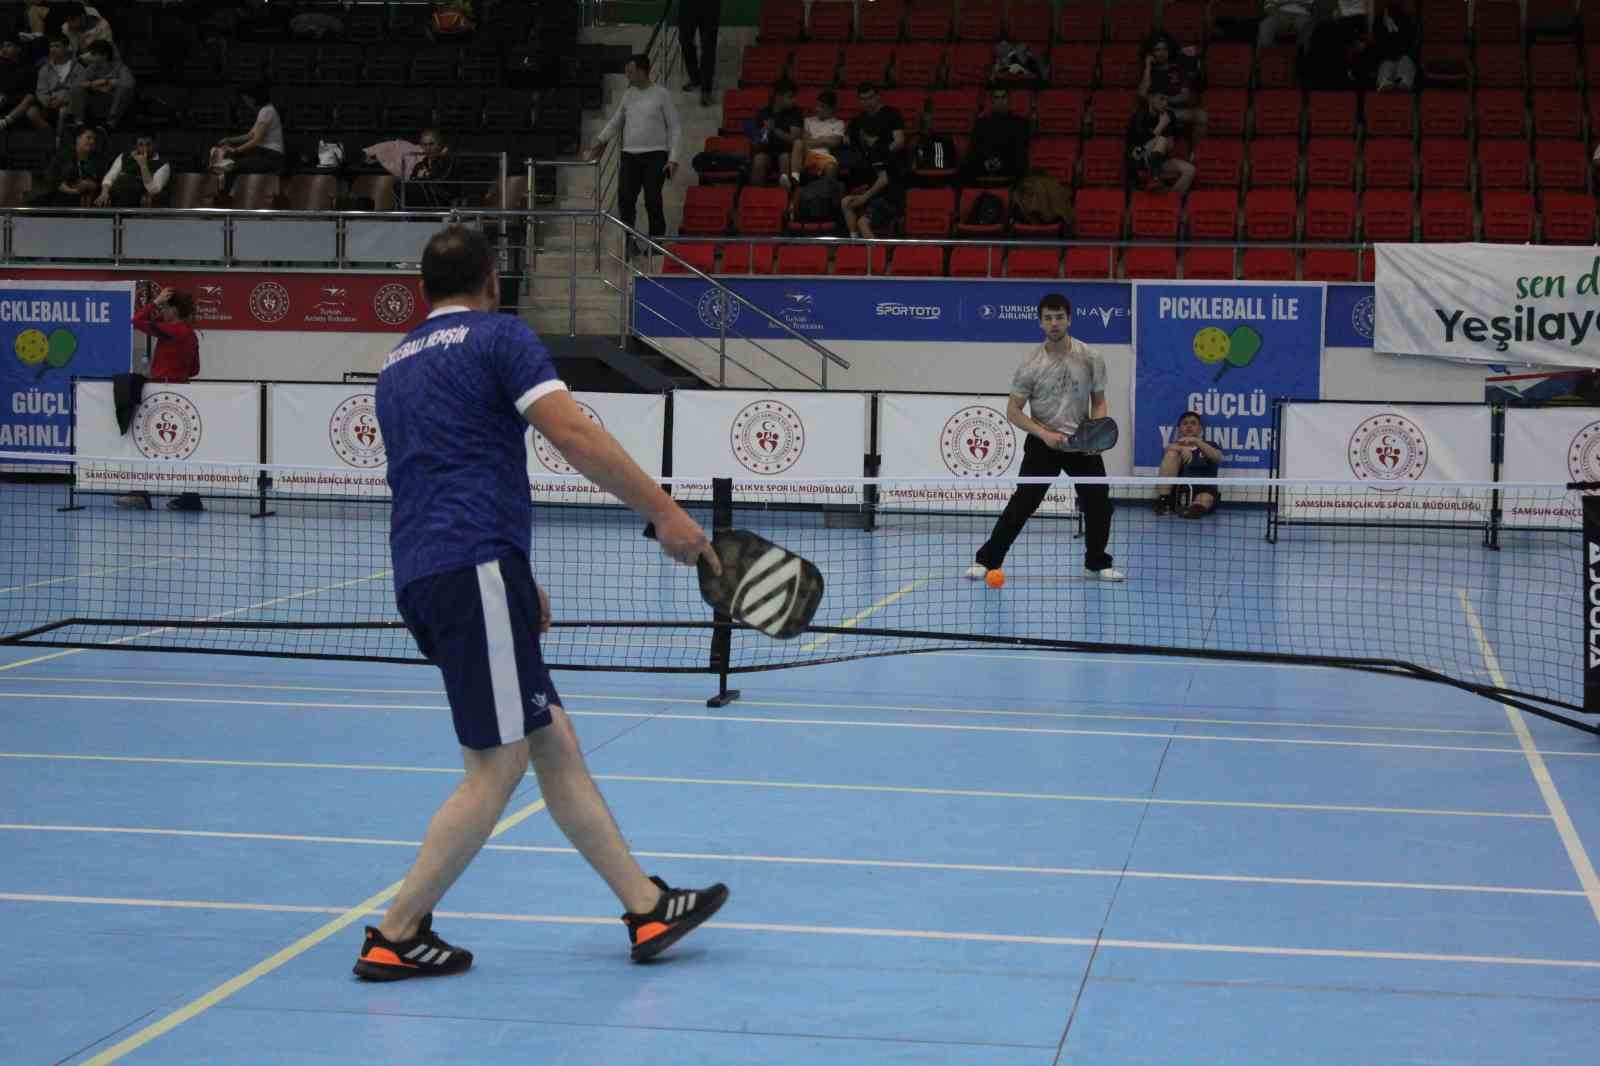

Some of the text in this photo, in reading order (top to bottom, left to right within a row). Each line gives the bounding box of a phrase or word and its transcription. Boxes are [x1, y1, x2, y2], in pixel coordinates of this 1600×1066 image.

[1516, 274, 1565, 299] sen
[85, 297, 110, 323] İLE
[1076, 306, 1131, 328] NAVE
[1159, 293, 1299, 320] PICKLEBALL İLE
[1436, 304, 1600, 352] Yeşilay
[1188, 388, 1266, 419] GÜÇLÜ
[1552, 507, 1584, 517] GENÇL
